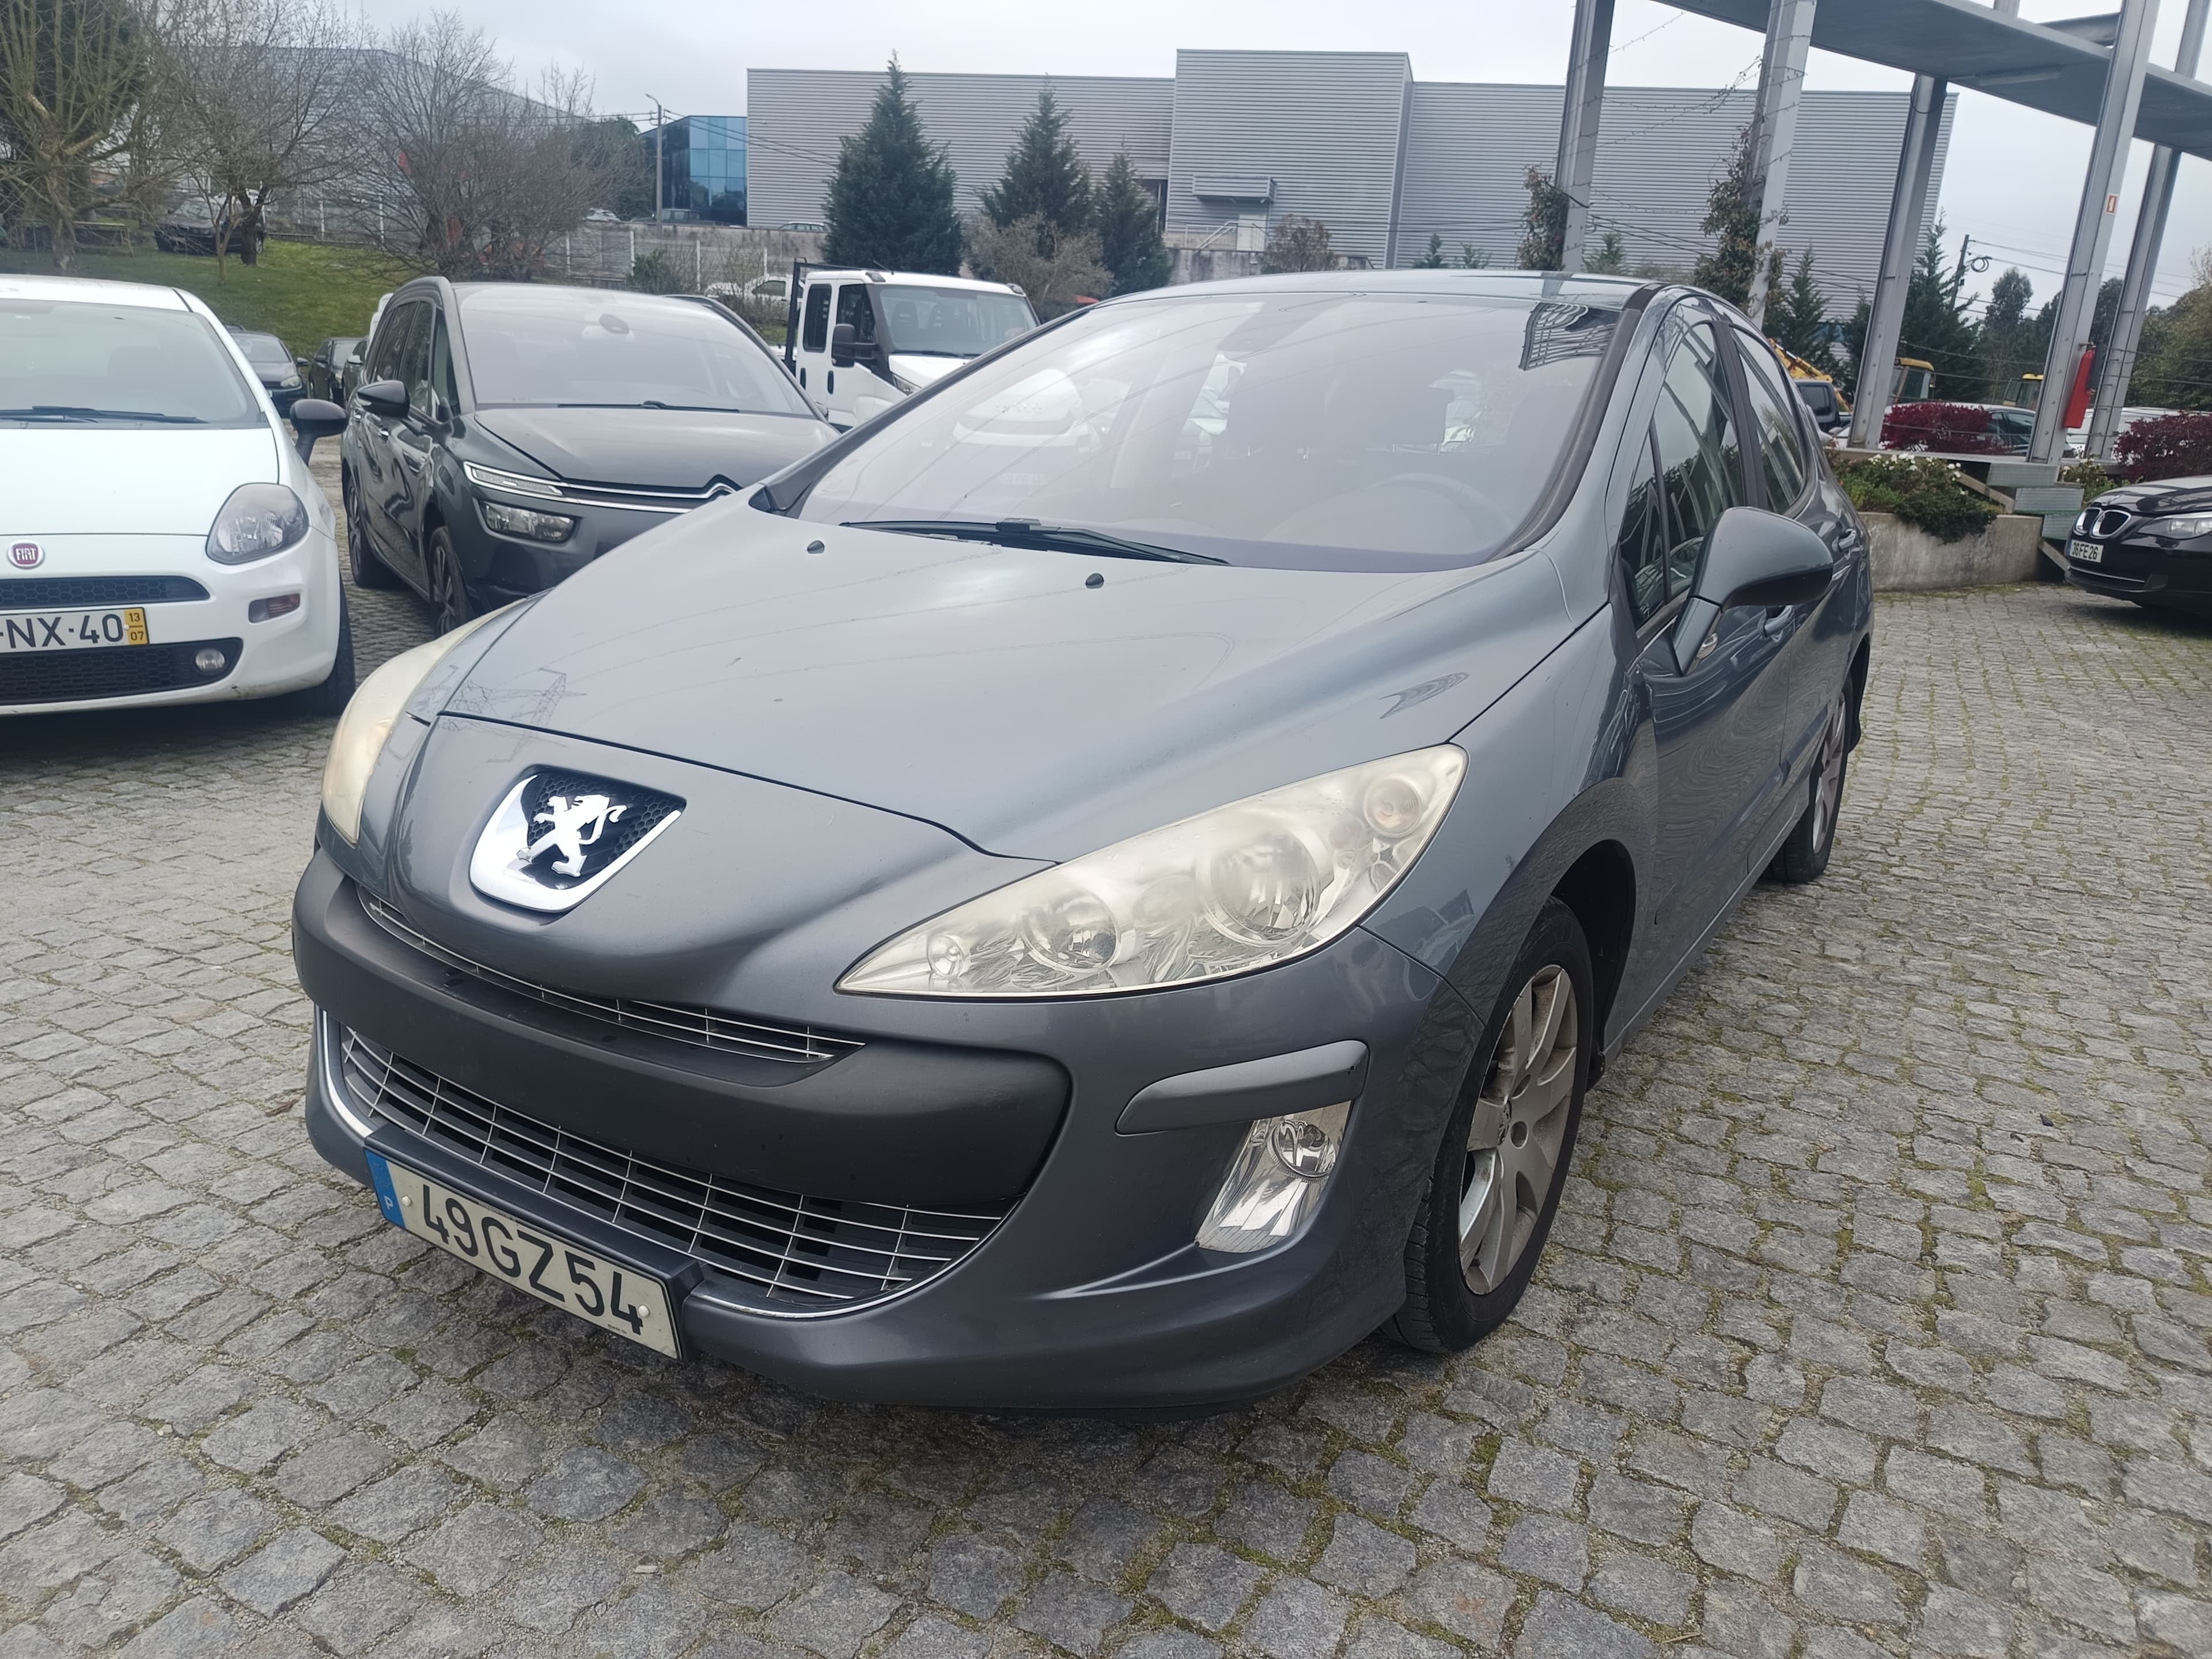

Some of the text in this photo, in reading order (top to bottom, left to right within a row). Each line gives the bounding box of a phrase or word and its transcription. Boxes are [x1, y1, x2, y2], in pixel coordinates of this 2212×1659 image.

[16, 547, 36, 561] FIAT
[128, 612, 141, 623] 13
[130, 631, 144, 641] 07
[384, 1195, 393, 1210] P
[422, 1184, 643, 1335] 49GZ54
